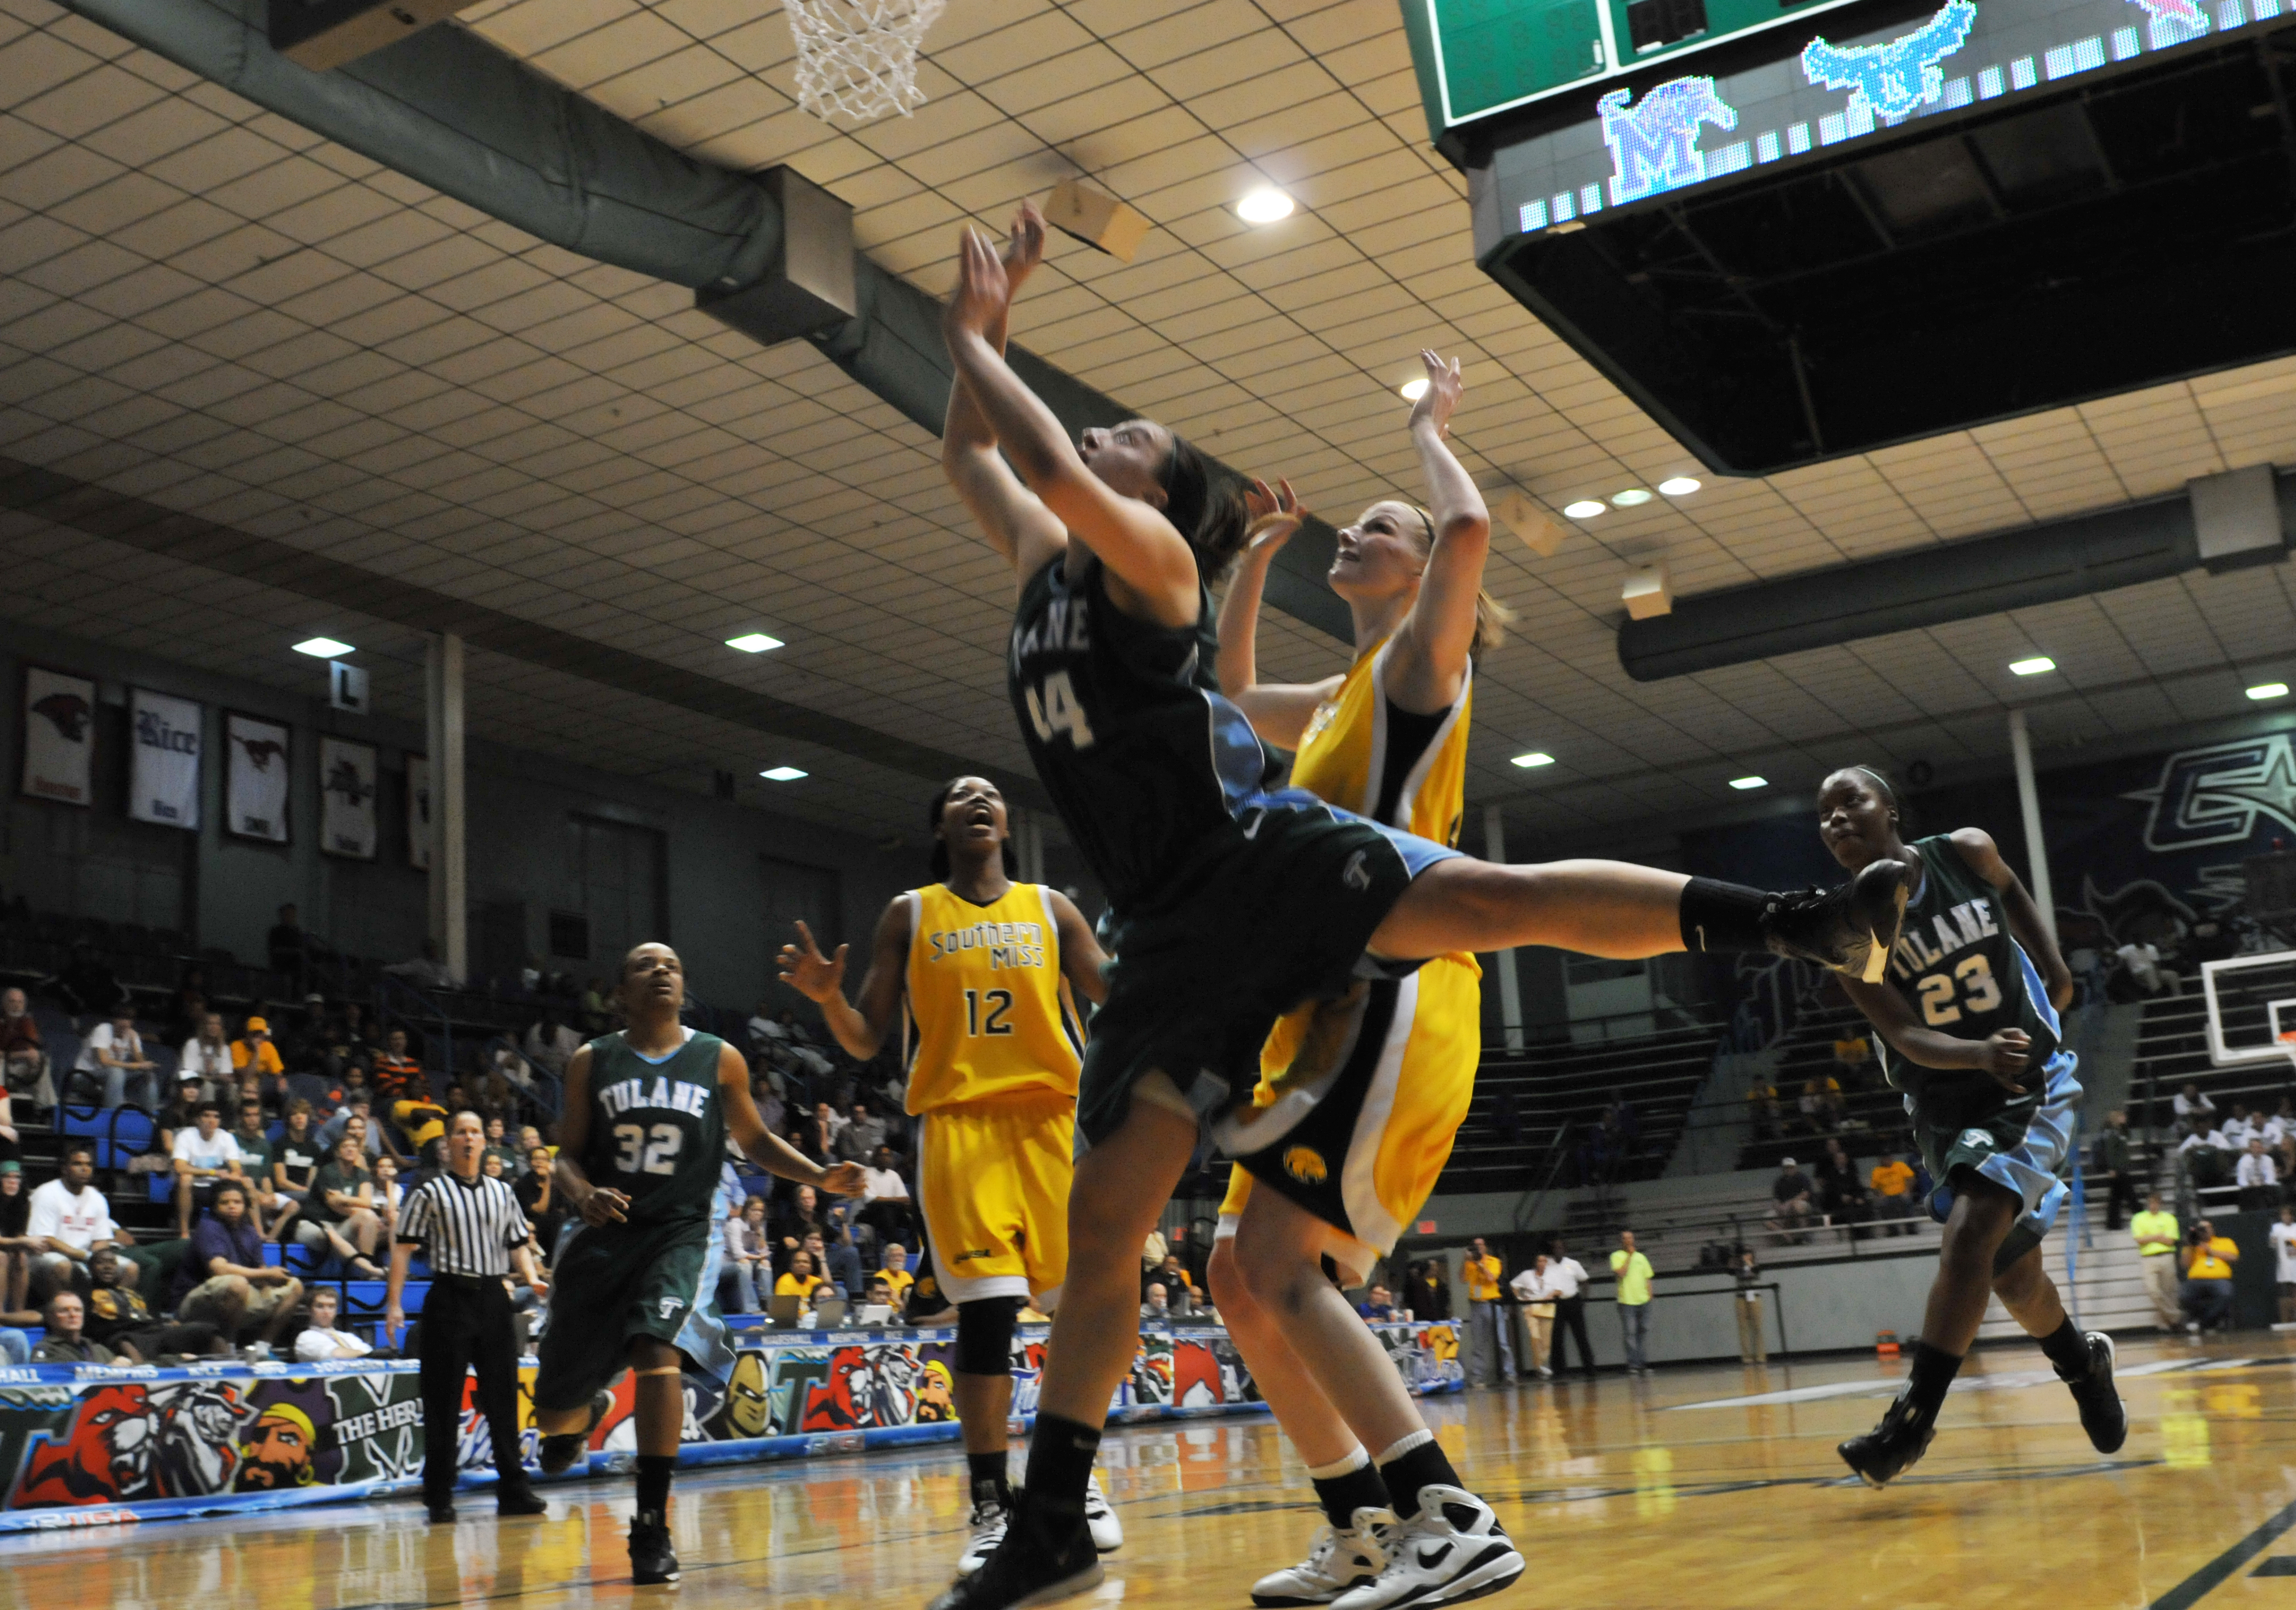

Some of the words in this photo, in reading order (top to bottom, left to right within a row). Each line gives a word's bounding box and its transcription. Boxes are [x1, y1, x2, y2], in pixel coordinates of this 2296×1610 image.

[340, 668, 360, 707] L
[135, 709, 197, 756] Rice
[964, 988, 1013, 1037] 12
[1917, 953, 2002, 1026] 23
[598, 1076, 710, 1119] TULANE
[613, 1123, 683, 1175] 32
[332, 1412, 376, 1444] THE
